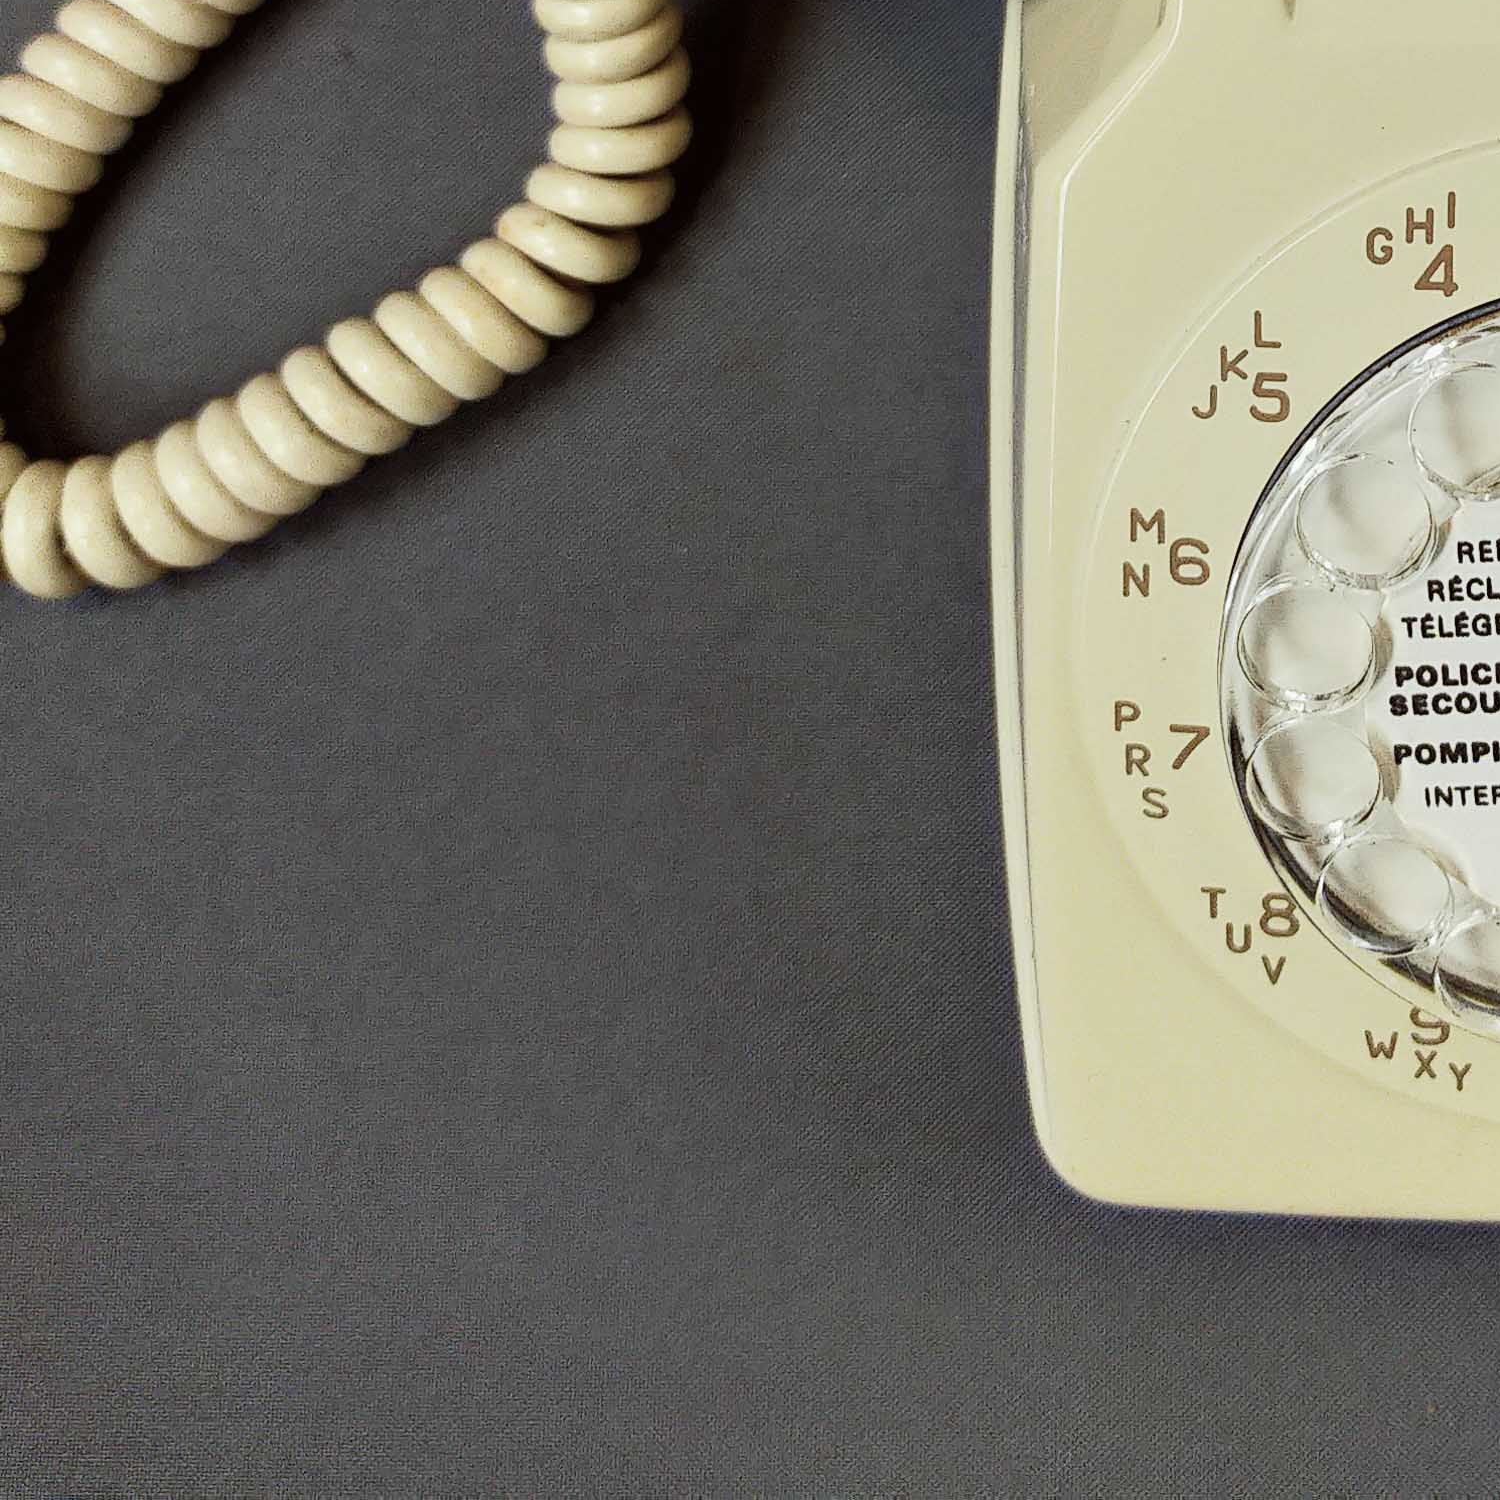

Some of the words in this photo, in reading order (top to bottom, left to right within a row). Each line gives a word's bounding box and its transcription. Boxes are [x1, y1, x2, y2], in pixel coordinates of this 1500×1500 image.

[1413, 244, 1459, 298] 4
[1249, 372, 1291, 423] 5
[1168, 538, 1211, 586] 6
[1168, 723, 1211, 771] 7
[1259, 890, 1301, 938] 8
[1408, 1005, 1451, 1046] 9
